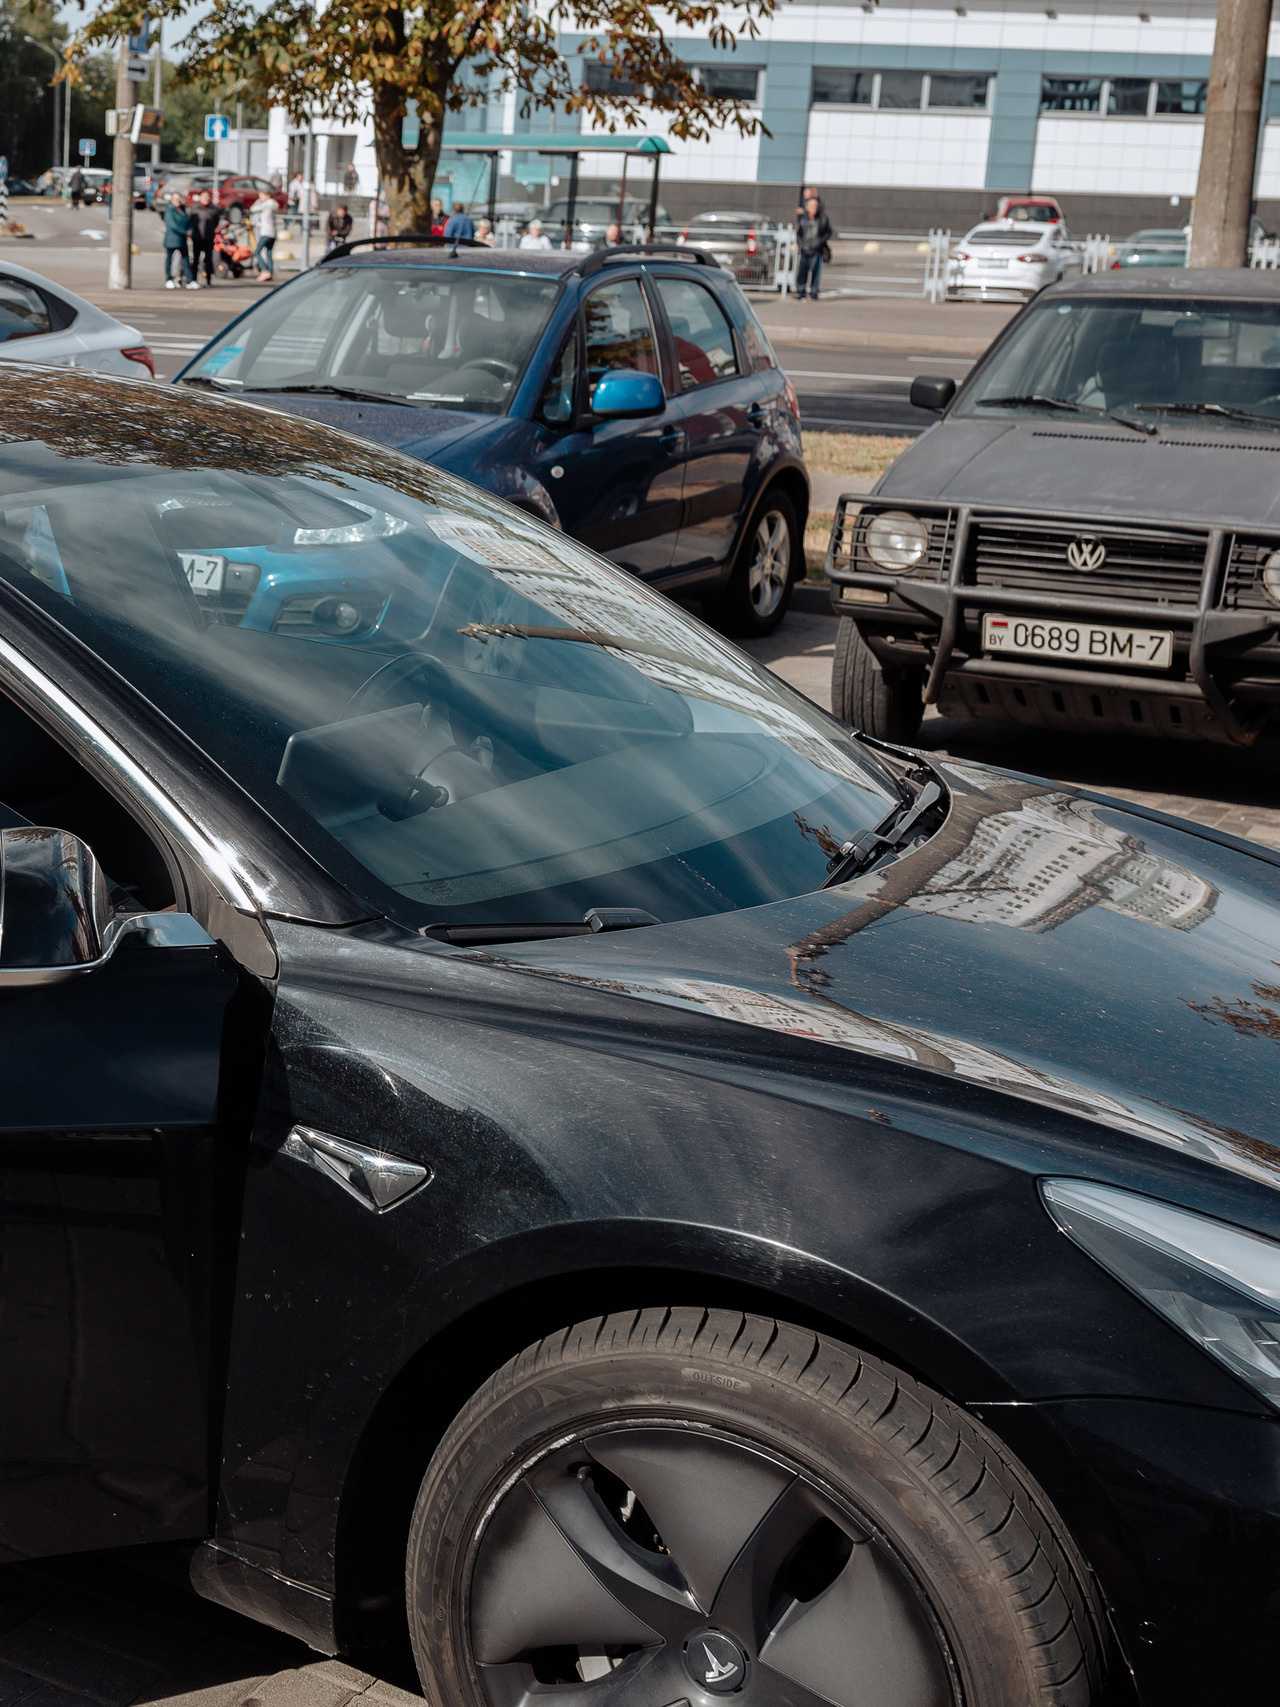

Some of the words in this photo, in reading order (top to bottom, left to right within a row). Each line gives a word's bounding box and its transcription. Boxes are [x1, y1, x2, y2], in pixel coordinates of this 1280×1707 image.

[989, 634, 1005, 646] BY
[1013, 623, 1080, 653] 0689
[1088, 630, 1165, 661] BM-7
[692, 1371, 741, 1391] OUTSIDE
